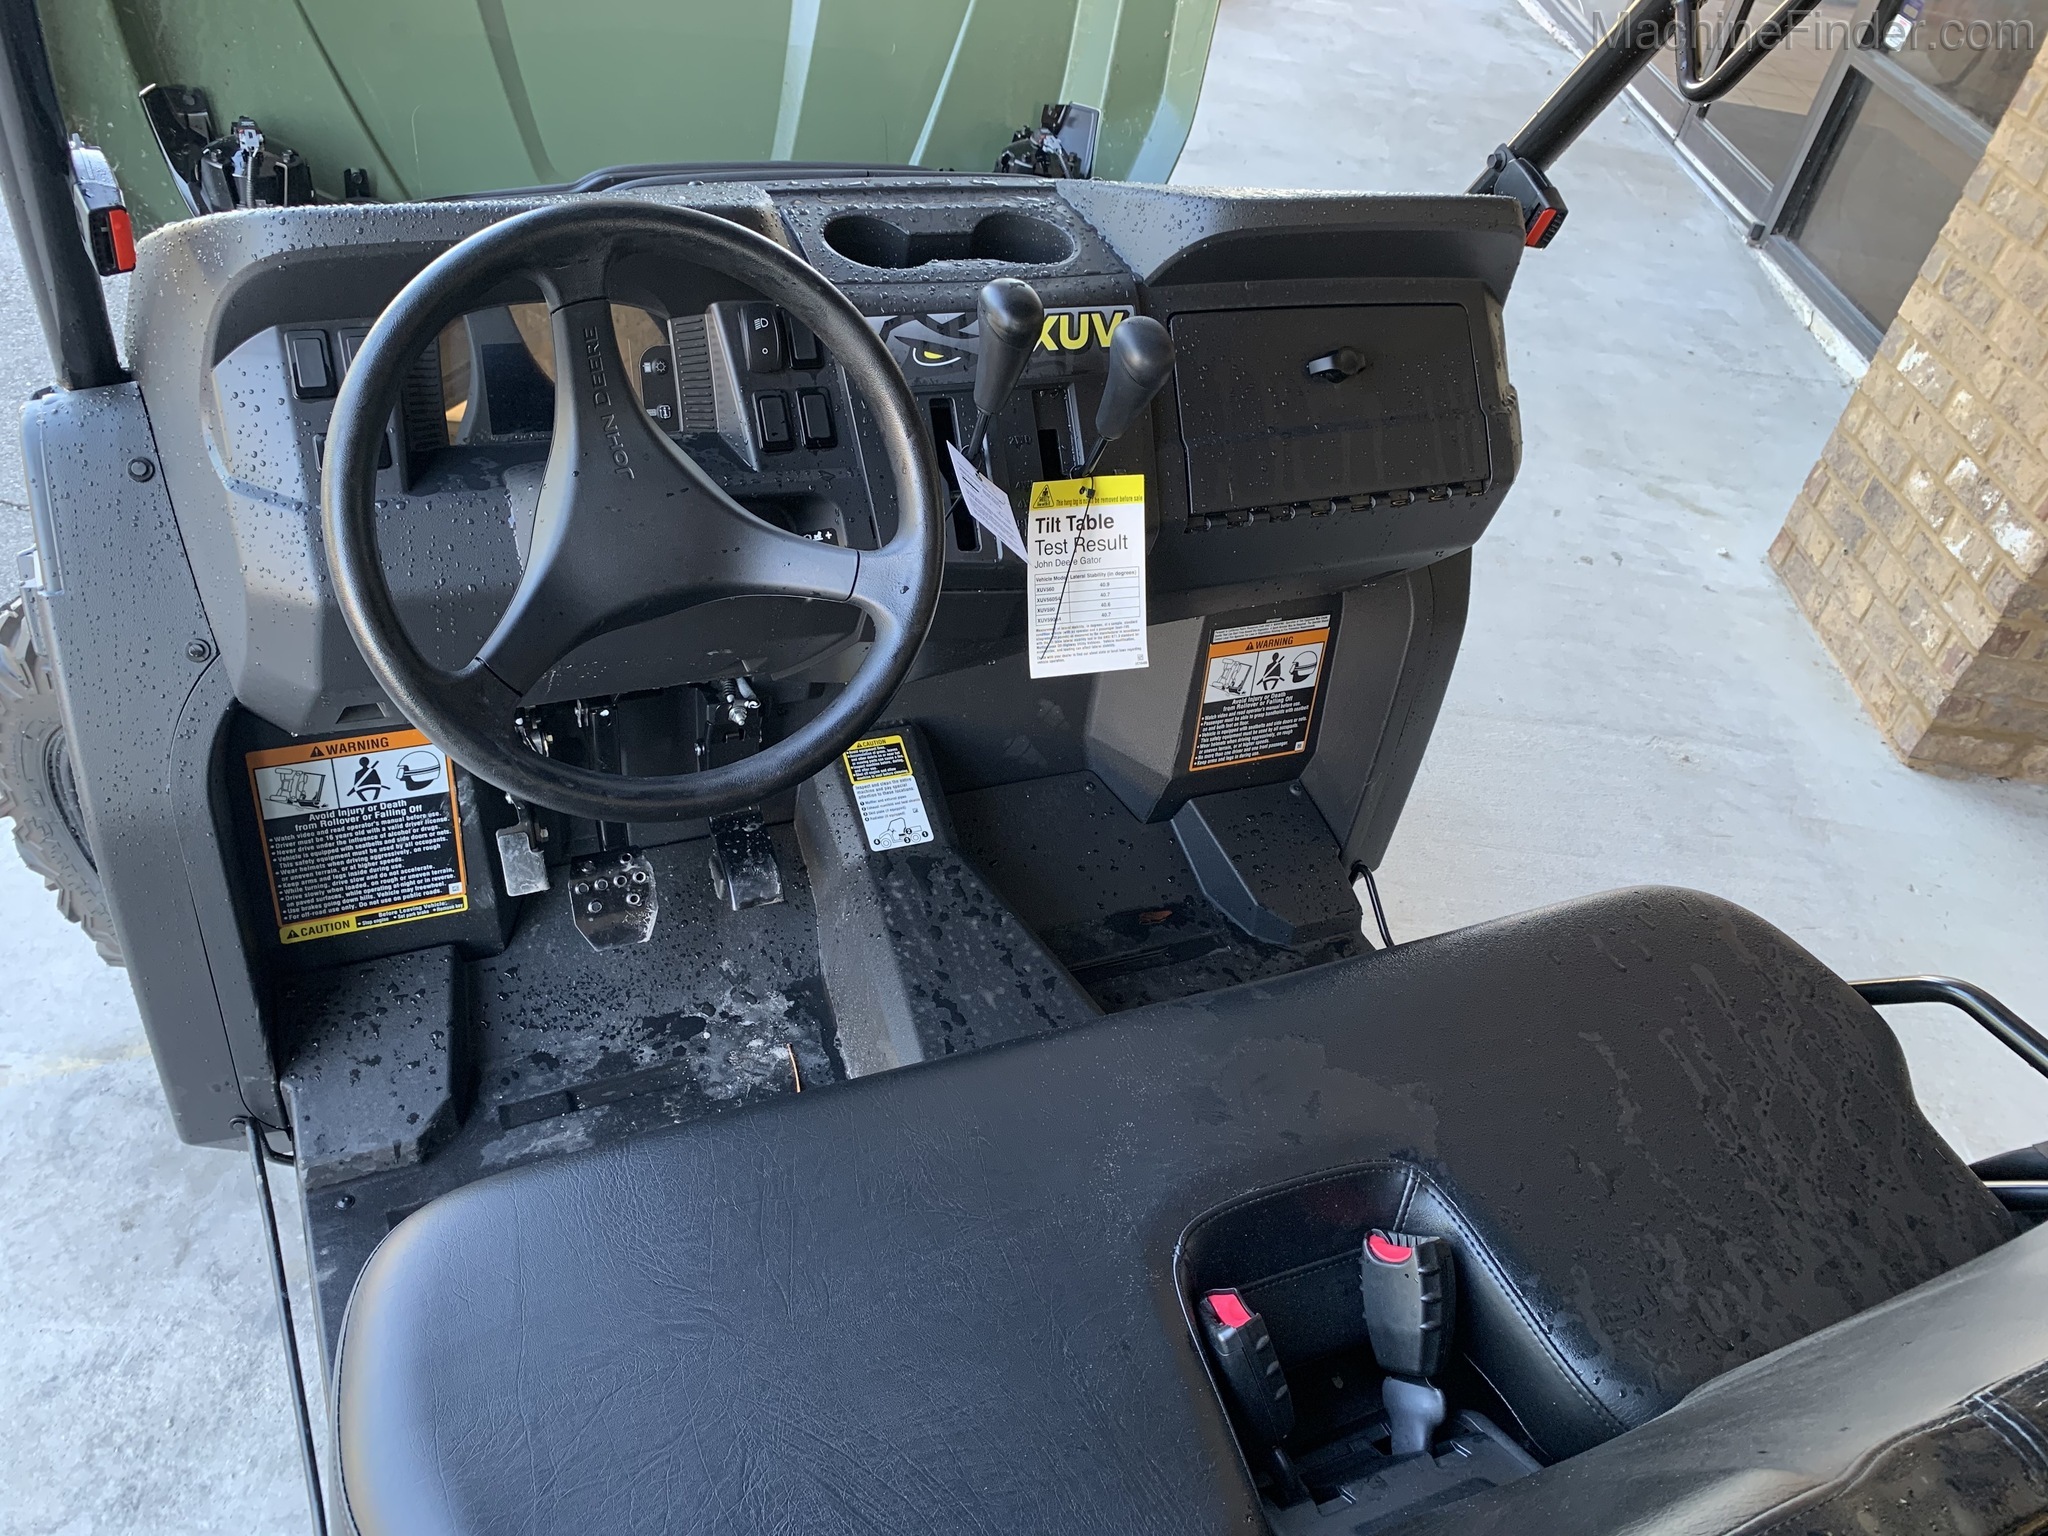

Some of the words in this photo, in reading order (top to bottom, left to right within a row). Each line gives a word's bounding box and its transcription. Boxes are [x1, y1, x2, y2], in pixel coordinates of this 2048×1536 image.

[1038, 312, 1127, 352] XUV
[583, 325, 612, 409] DEERE
[600, 413, 636, 480] JOHN
[1035, 516, 1060, 533] Tilt
[1066, 513, 1113, 531] Table
[1034, 538, 1067, 556] Test
[1074, 533, 1127, 553] Result
[1034, 559, 1052, 568] John
[1080, 556, 1101, 564] Gator
[1254, 636, 1293, 649] WARNING
[1236, 701, 1258, 709] Rollover
[1265, 697, 1284, 705] Falling
[326, 737, 389, 755] WARNING
[294, 821, 316, 831] from
[319, 815, 359, 827] Rollover
[374, 807, 406, 819] Falling
[408, 805, 422, 813] Off
[308, 811, 334, 821] Avoid
[337, 806, 365, 817] Injury
[379, 799, 406, 809] Death
[274, 834, 295, 842] Watch
[346, 820, 379, 831] operator's
[380, 816, 404, 825] manual
[405, 813, 426, 821] before
[275, 840, 296, 848] Driver
[335, 832, 353, 840] years
[424, 816, 449, 824] license.
[276, 847, 295, 855] Never
[348, 834, 378, 843] influence
[387, 829, 411, 837] alcohol
[420, 824, 440, 832] drugs.
[277, 853, 301, 861] Vehicle
[309, 847, 339, 857] equipped
[354, 840, 382, 849] seatbelts
[410, 832, 427, 840] doors
[294, 858, 314, 866] safety
[316, 852, 350, 863] equipment
[414, 836, 448, 847] occupants.
[299, 863, 325, 871] helmets
[327, 859, 344, 867] when
[345, 856, 368, 865] driving
[369, 848, 411, 861] aggressively,
[422, 844, 440, 852] rough
[282, 880, 299, 888] Keep
[332, 872, 346, 880] legs
[368, 865, 389, 874] during
[283, 886, 302, 894] While
[304, 882, 330, 891] turning,
[400, 864, 435, 874] accelerate.
[290, 872, 314, 880] uneven
[315, 867, 339, 875] terrain,
[357, 861, 378, 869] higher
[379, 856, 404, 866] speeds.
[300, 902, 321, 910] brakes
[323, 899, 340, 907] going
[376, 889, 399, 897] Vehicle
[414, 881, 446, 891] freewheel.
[300, 908, 326, 917] off-road
[340, 903, 357, 911] only.
[402, 892, 421, 900] public
[423, 888, 442, 896] roads.
[300, 920, 350, 936] CAUTION
